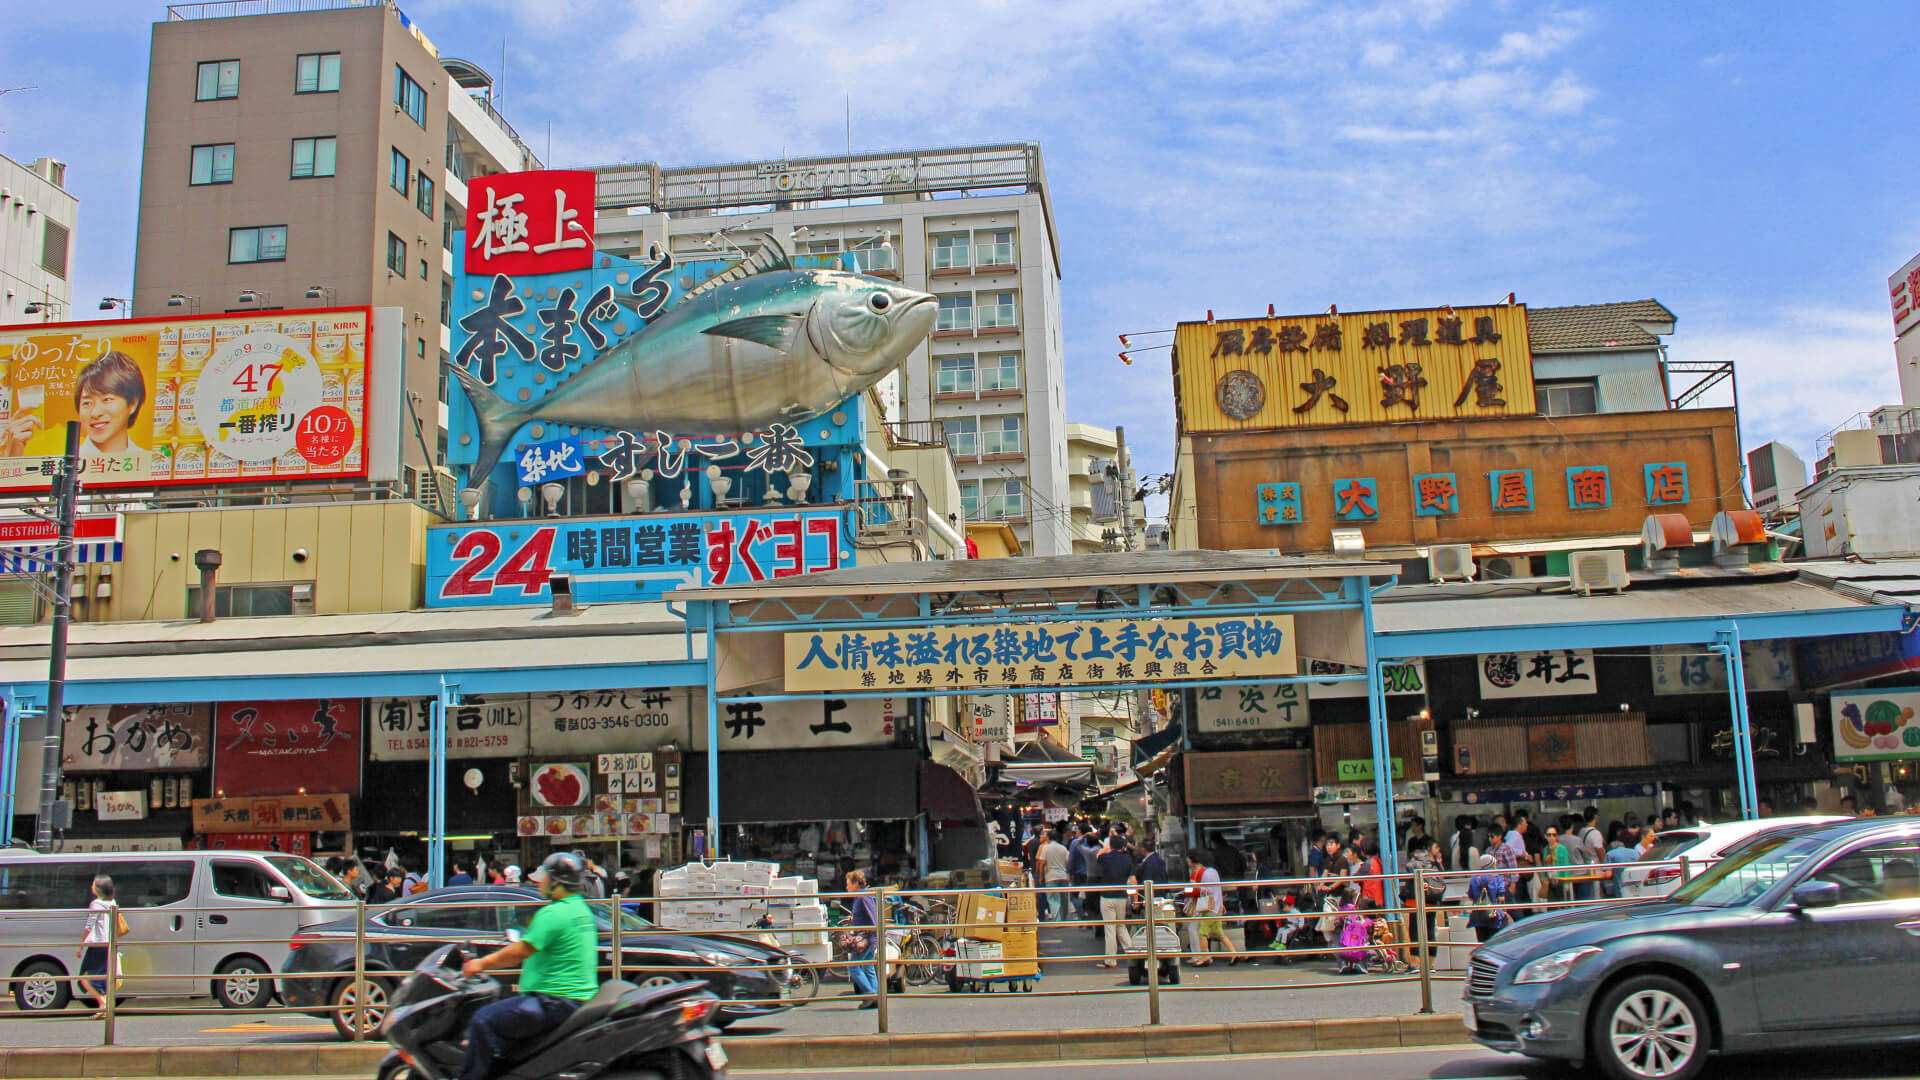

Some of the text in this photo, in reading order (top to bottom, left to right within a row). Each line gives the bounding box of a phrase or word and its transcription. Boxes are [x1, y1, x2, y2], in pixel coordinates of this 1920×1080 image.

[759, 159, 923, 192] TOKYU STAY
[472, 187, 587, 261] 極上
[334, 321, 359, 330] KIRIN
[455, 240, 674, 385] 本まぐろ
[122, 335, 148, 344] KIRIN
[1361, 315, 1502, 350] 料理道具
[11, 335, 112, 366] ゆったり
[232, 363, 283, 393] 47
[1293, 358, 1507, 414] 大野屋
[303, 414, 348, 434] 10万
[25, 458, 87, 476] 一番り
[520, 442, 584, 485] 築地
[598, 423, 815, 482] すし一番
[441, 516, 840, 597] 24 時間営業 すぐヨコ
[796, 618, 1284, 671] 人情味溢れる築地で上手なお買物
[861, 659, 1219, 687] 築地場外市場商店街振興組合
[1526, 649, 1590, 684] 井上
[724, 691, 853, 740] 井上
[81, 717, 193, 757] おかめ
